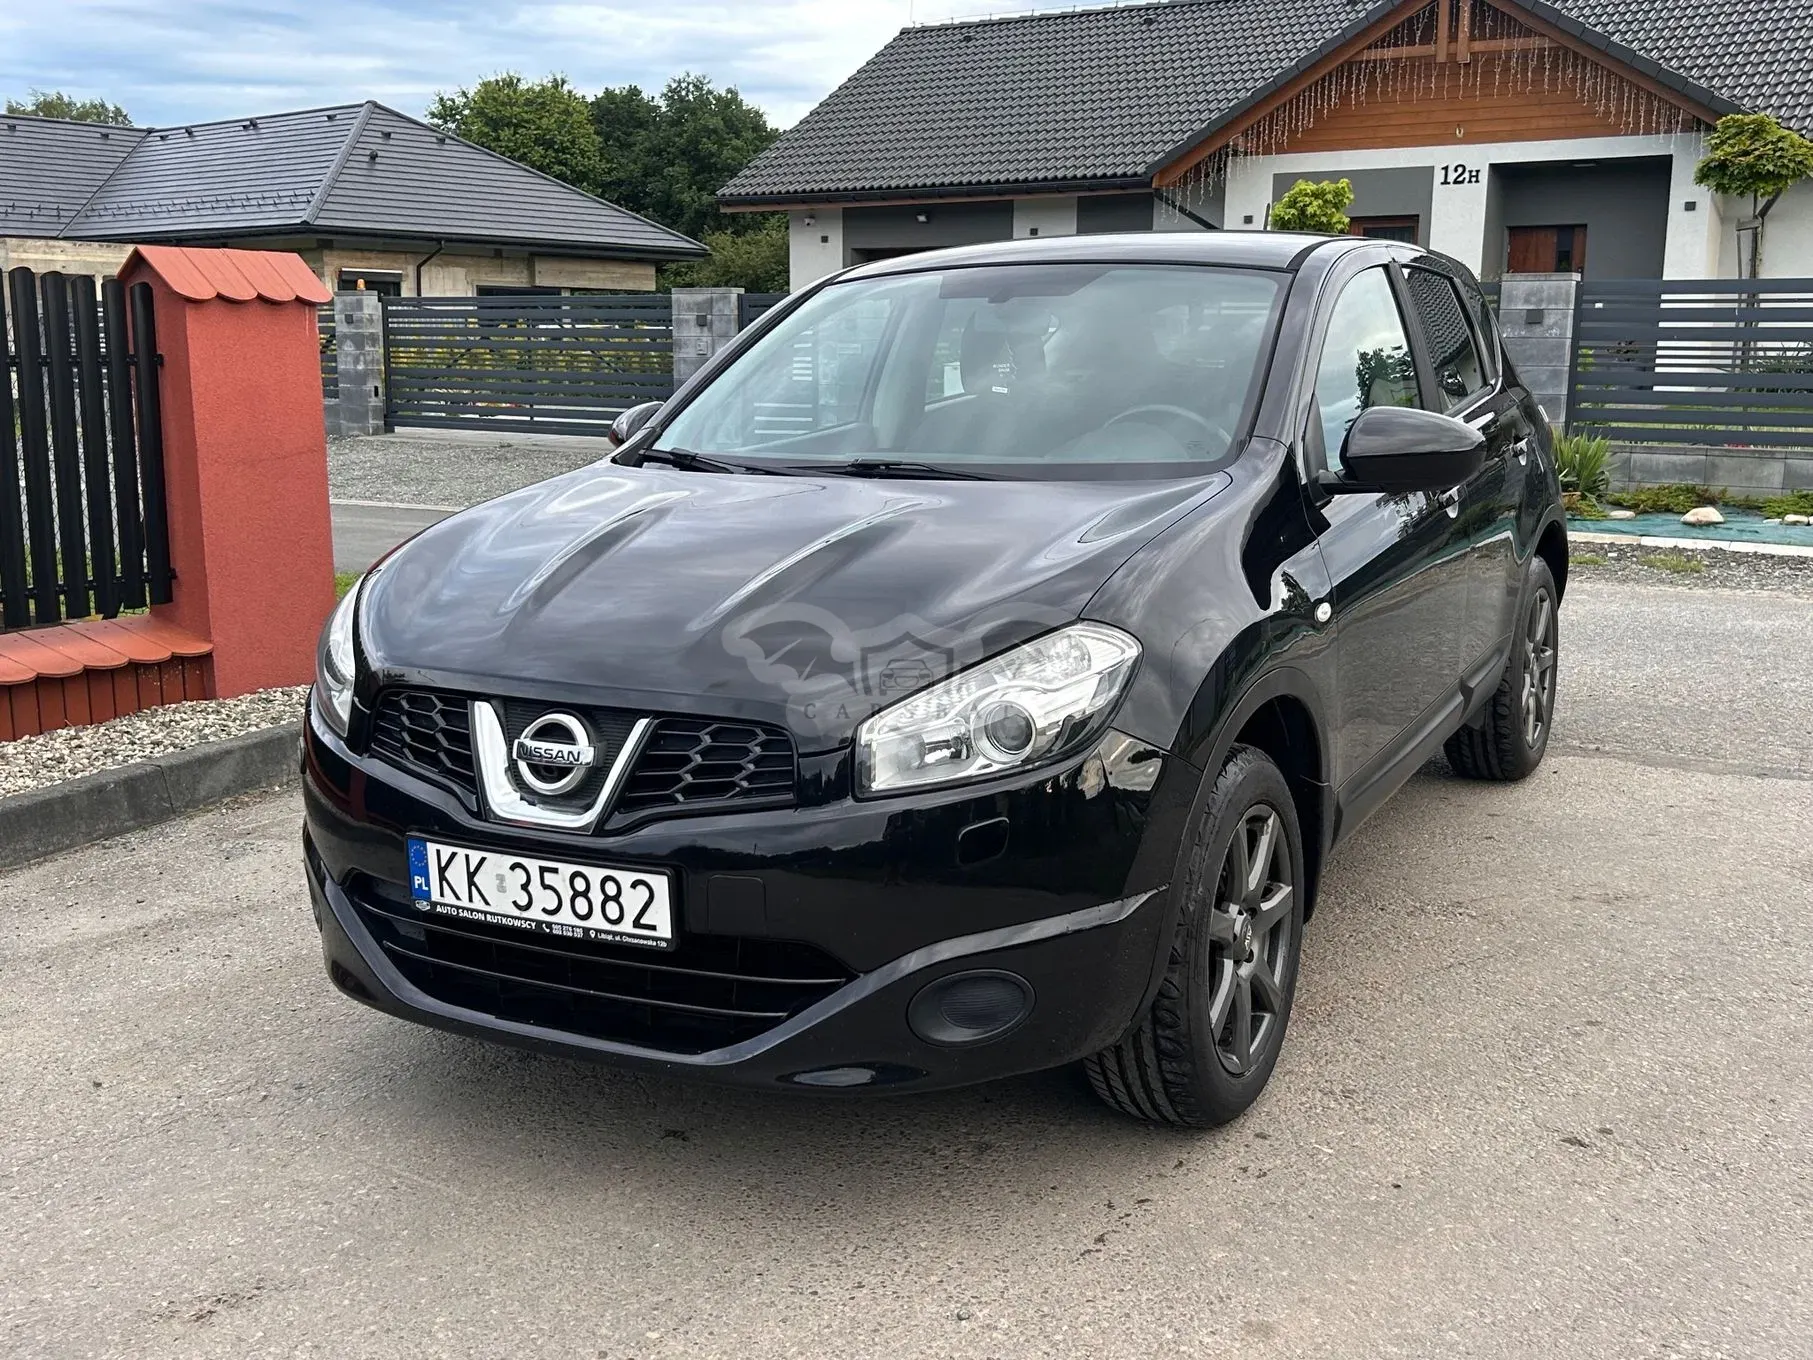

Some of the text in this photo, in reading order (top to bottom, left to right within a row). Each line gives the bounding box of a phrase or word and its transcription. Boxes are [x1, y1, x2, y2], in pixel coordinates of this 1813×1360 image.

[1440, 164, 1481, 185] 12H
[519, 742, 581, 763] NISSAN
[414, 875, 429, 891] PL
[436, 849, 658, 932] KK 35882
[436, 904, 458, 916] AUTO
[458, 908, 485, 921] SALON
[486, 913, 537, 930] RUTKOWSCY
